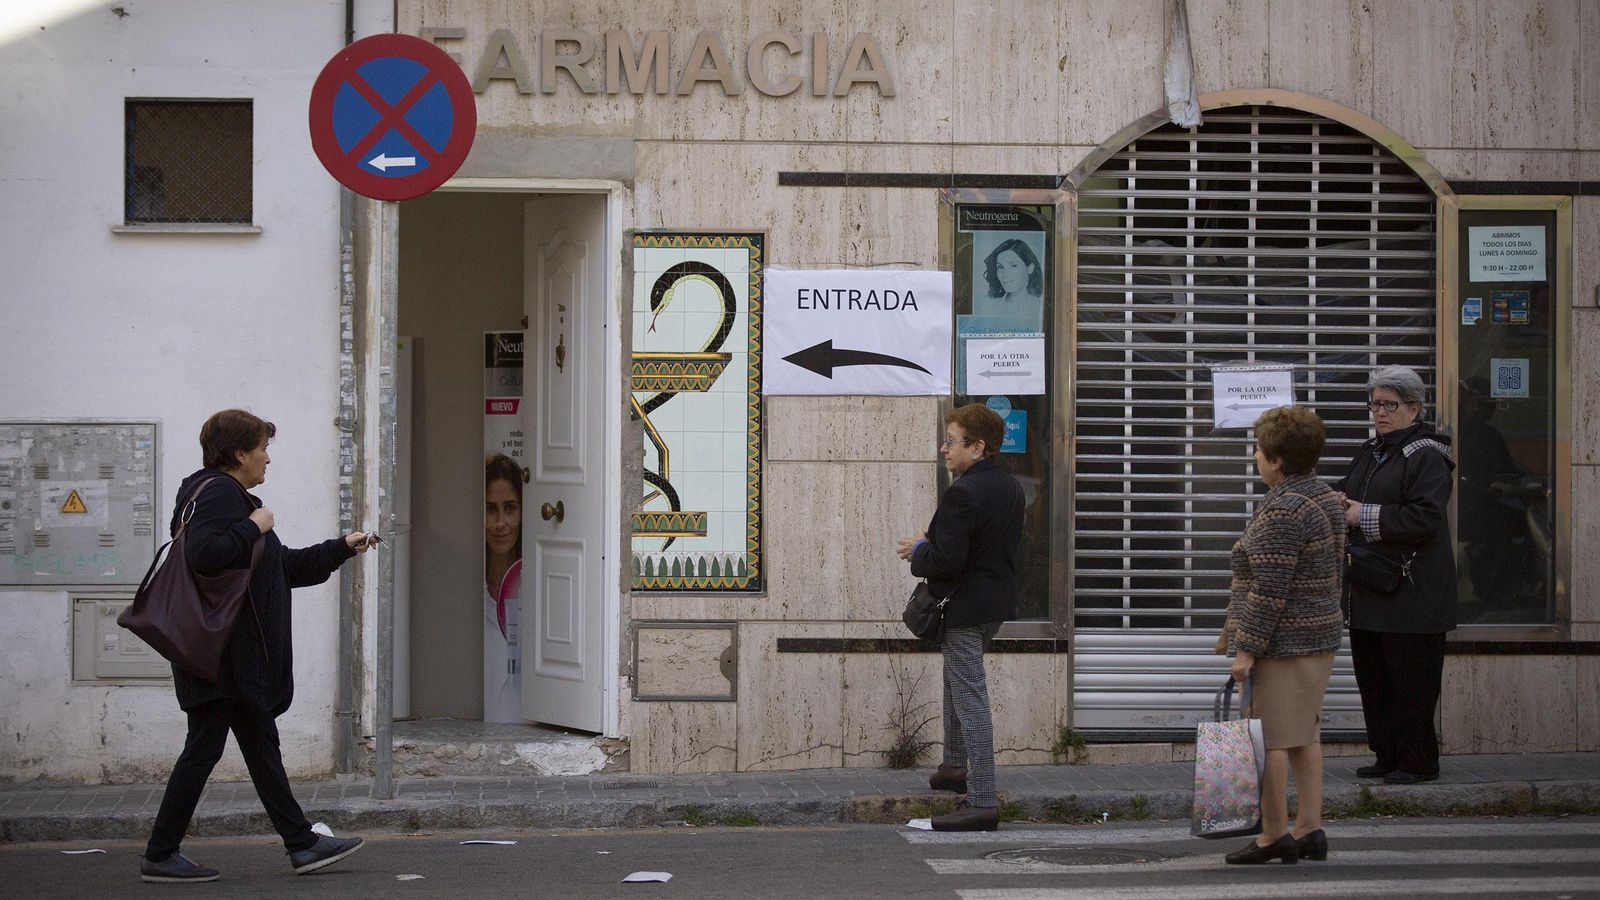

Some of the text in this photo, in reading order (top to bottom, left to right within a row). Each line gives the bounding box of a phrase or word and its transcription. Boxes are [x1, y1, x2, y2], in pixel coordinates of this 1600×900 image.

[966, 210, 1019, 223] Neutrogena
[797, 288, 919, 312] ENTRADA
[491, 402, 514, 412] NUEVO
[511, 449, 519, 457] de
